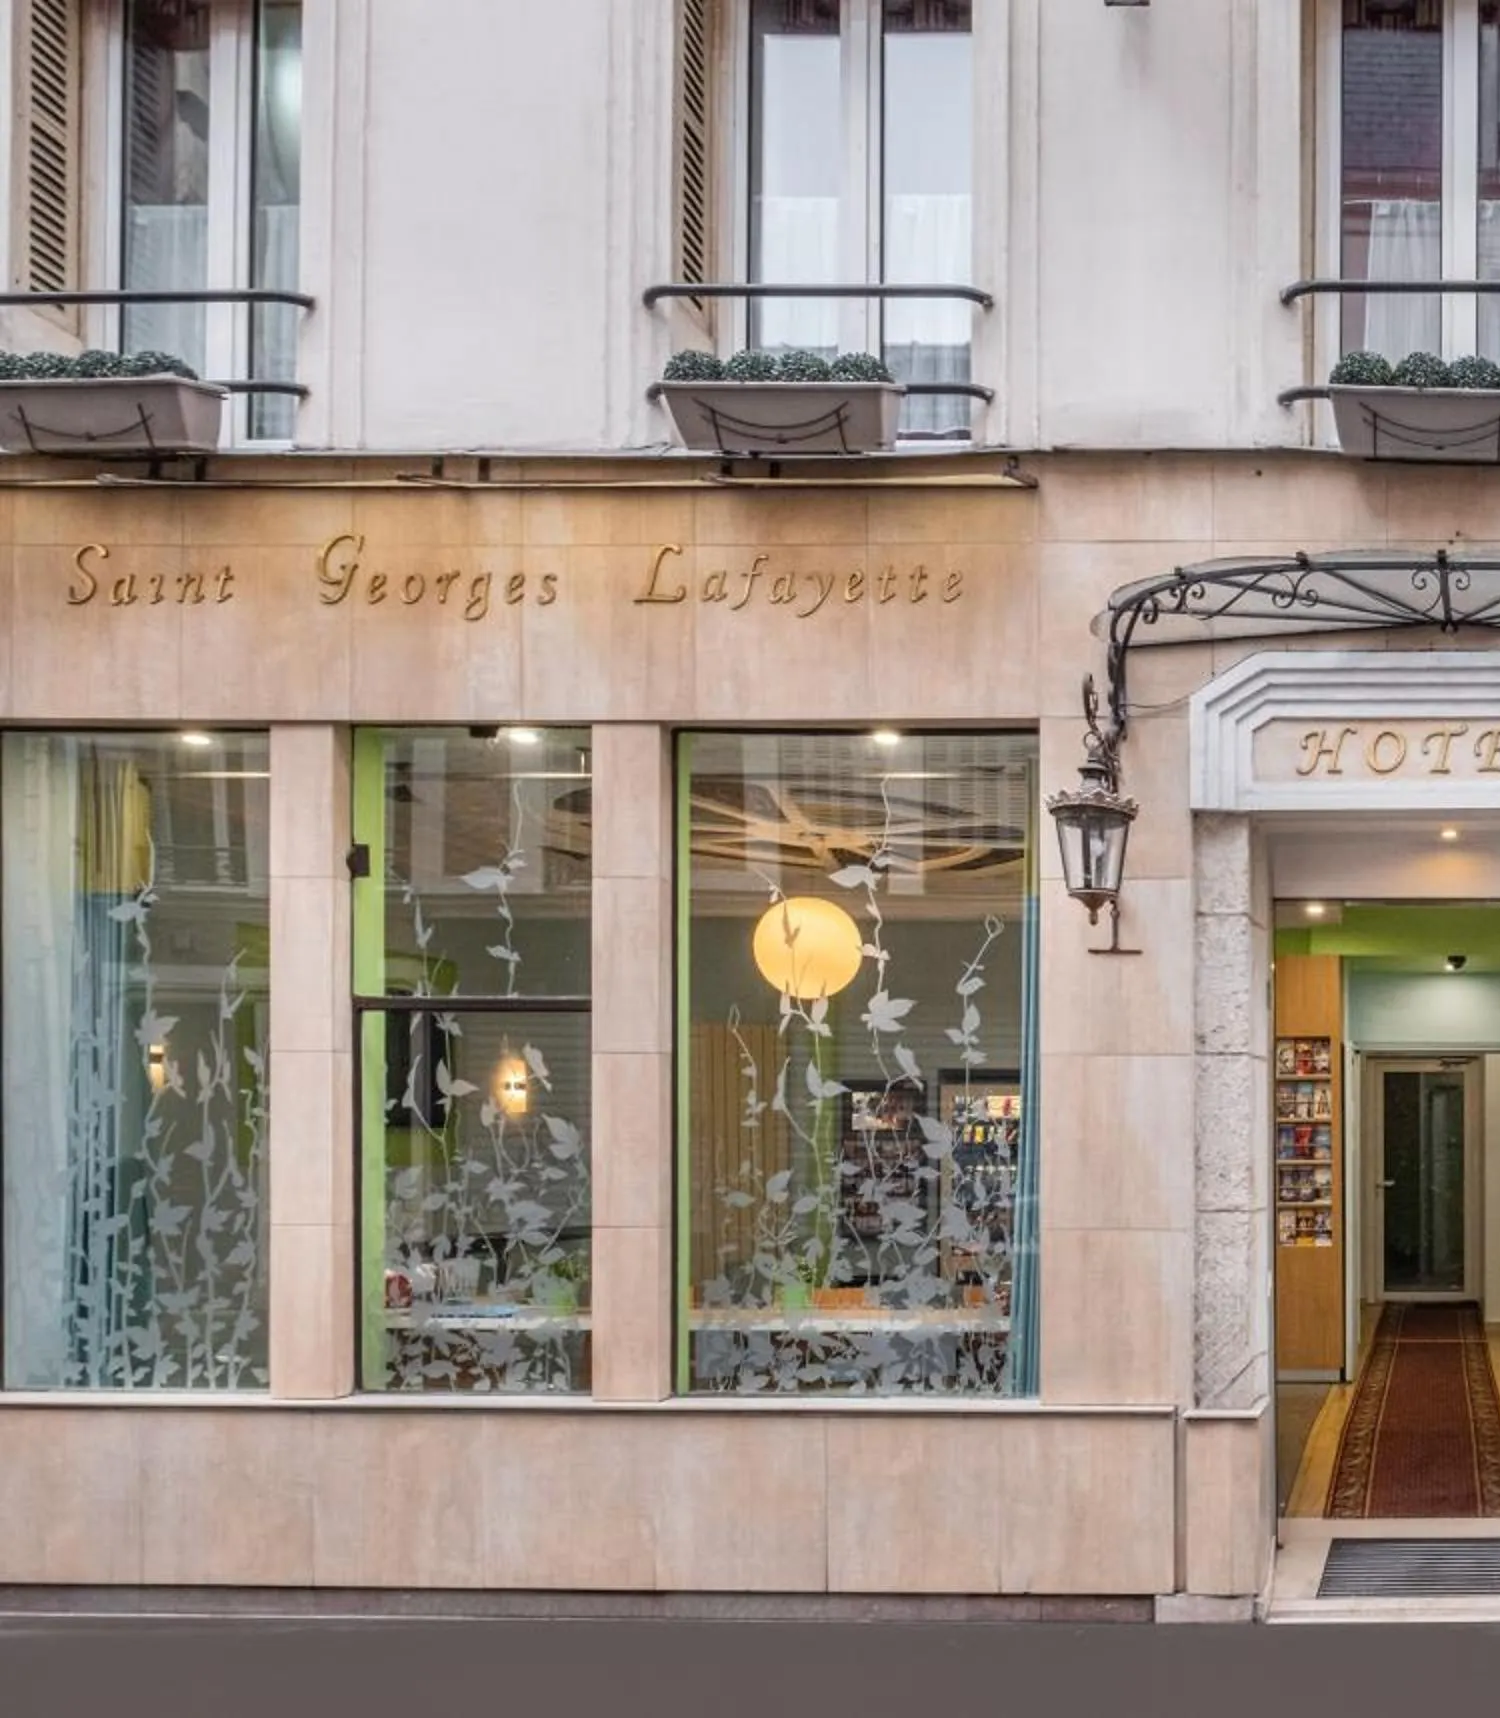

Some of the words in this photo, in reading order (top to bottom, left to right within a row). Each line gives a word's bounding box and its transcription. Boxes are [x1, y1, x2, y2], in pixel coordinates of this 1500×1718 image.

[66, 542, 237, 607] Saint
[314, 533, 561, 622] Georges
[631, 542, 966, 618] Lafayette
